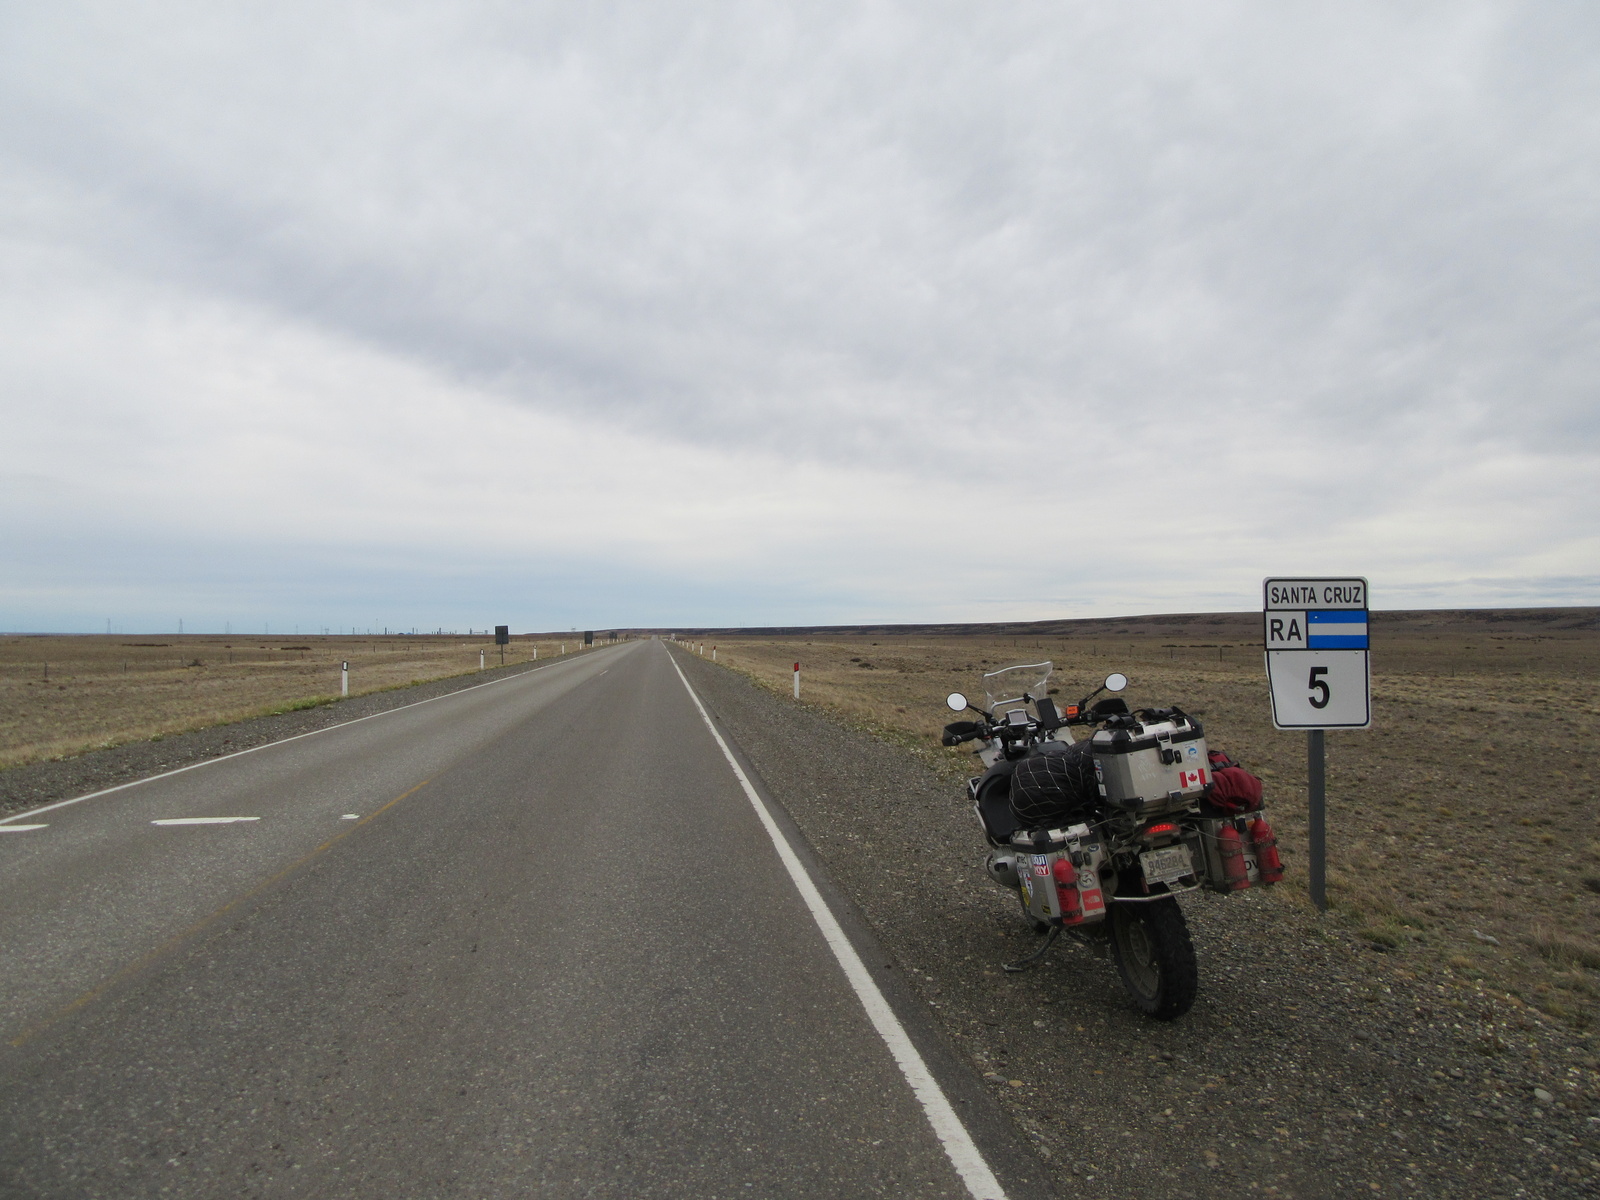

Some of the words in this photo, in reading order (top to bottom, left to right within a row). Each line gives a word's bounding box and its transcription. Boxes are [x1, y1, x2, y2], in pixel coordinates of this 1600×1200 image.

[1271, 587, 1317, 604] SANTA
[1323, 586, 1361, 604] CRUZ
[1270, 618, 1302, 641] RA
[1308, 666, 1330, 709] 5
